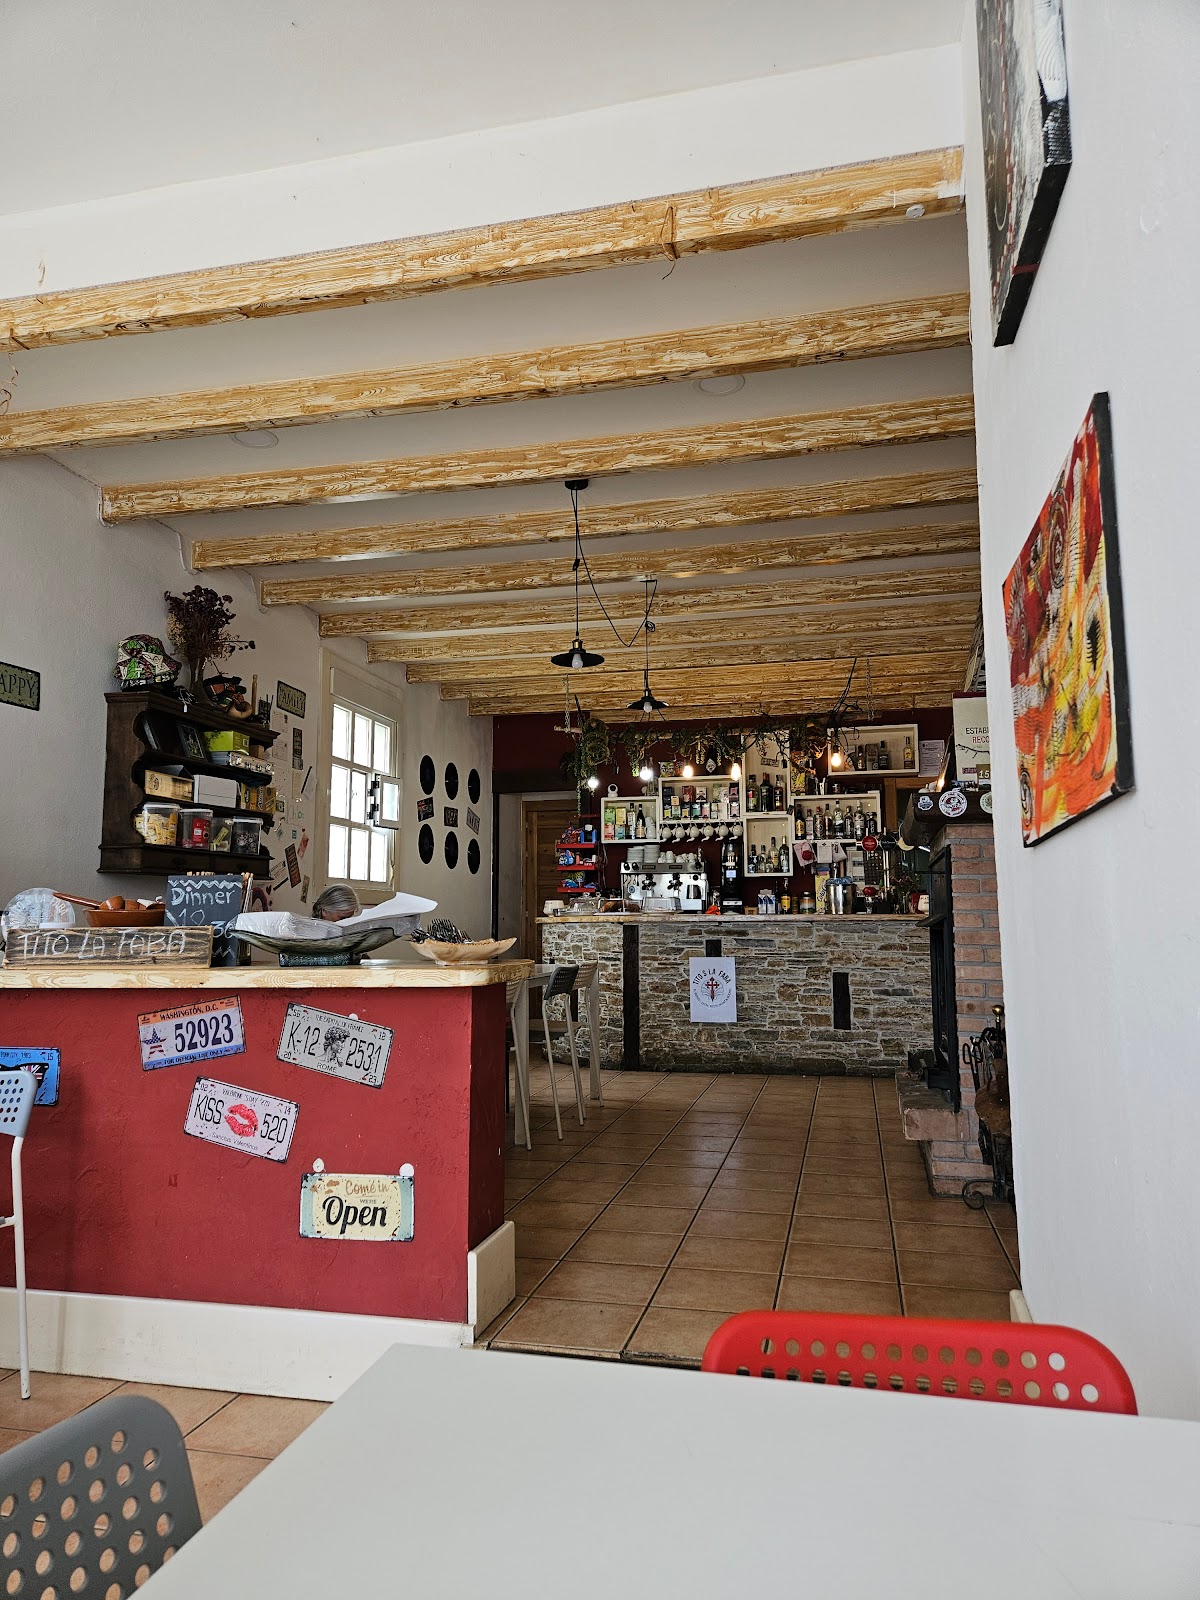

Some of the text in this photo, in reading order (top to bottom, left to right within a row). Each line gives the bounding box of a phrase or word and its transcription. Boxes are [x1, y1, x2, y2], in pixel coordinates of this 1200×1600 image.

[978, 770, 990, 779] 15
[171, 886, 235, 906] Dinner
[17, 929, 187, 960] TITO LA FABA
[205, 1003, 219, 1012] D.C.
[174, 1013, 234, 1053] 52923
[287, 1021, 382, 1074] K-12 2531
[316, 1062, 338, 1073] ROME
[193, 1093, 288, 1144] KISS 520
[345, 1180, 389, 1196] Come in
[322, 1196, 388, 1235] Open
